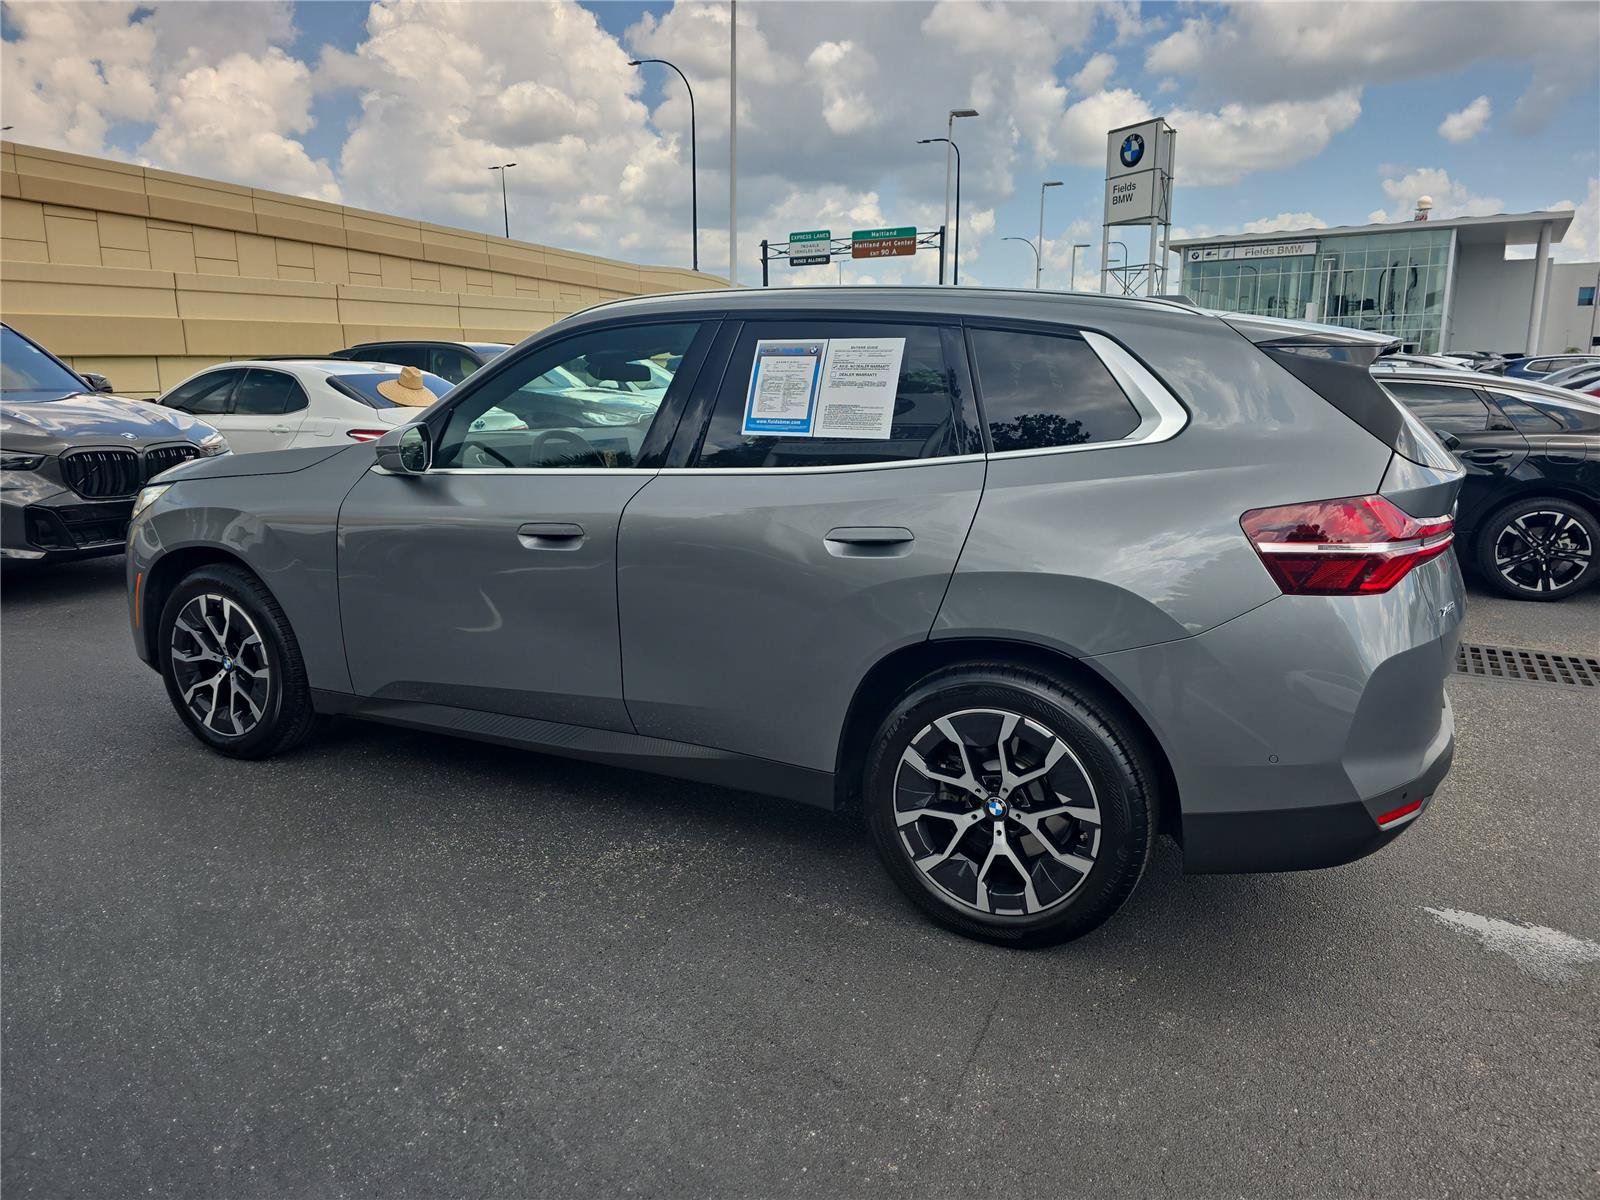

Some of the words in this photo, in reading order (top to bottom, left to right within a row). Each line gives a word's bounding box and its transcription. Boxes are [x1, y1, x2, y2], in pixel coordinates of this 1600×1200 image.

[1113, 182, 1137, 194] Fields
[1112, 193, 1134, 206] BMW
[1244, 247, 1275, 257] Fields
[1277, 244, 1305, 255] BMW
